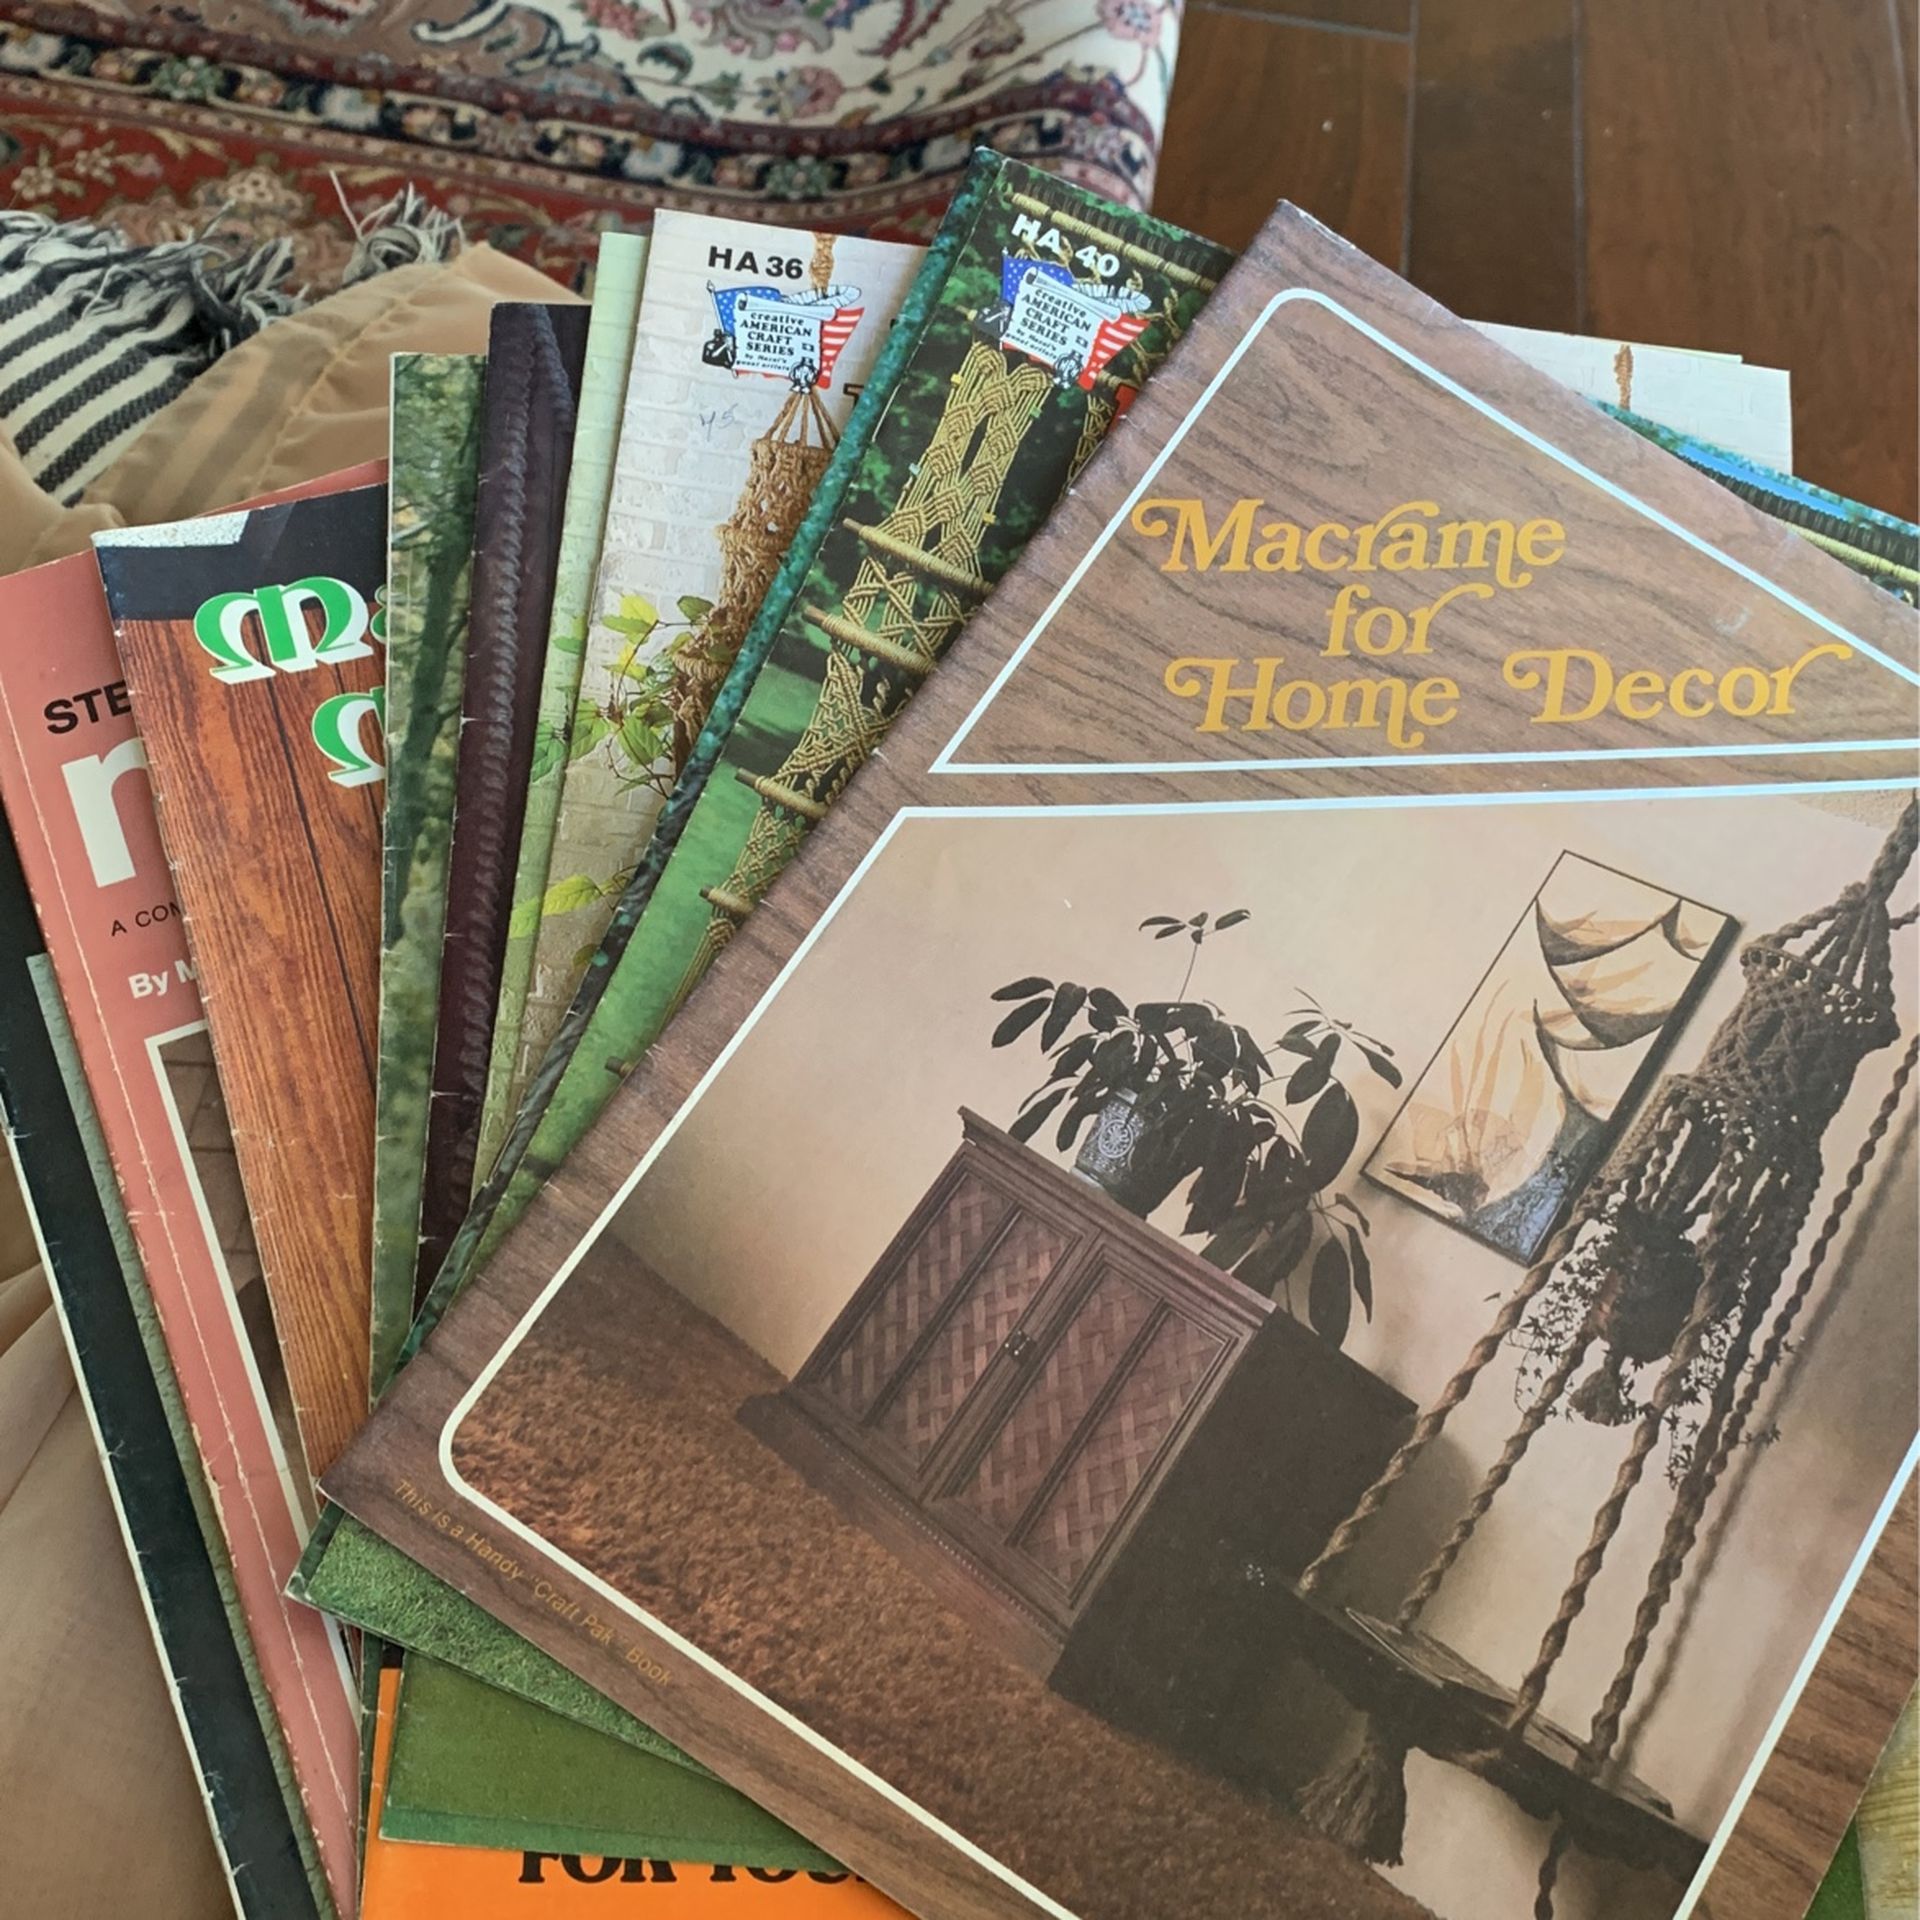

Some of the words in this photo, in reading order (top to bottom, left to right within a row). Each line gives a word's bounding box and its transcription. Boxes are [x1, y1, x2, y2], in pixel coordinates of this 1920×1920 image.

[1011, 213, 1061, 254] HA
[1075, 245, 1120, 278] 40
[708, 245, 759, 274] HA
[766, 256, 804, 279] 36
[1021, 294, 1092, 332] AMERICAN
[1035, 288, 1087, 318] creative
[740, 319, 813, 337] AMERICAN
[750, 312, 805, 326] creative
[1021, 318, 1068, 346] SERIES
[1025, 306, 1070, 333] CRAFT
[746, 341, 795, 357] SERIES
[747, 331, 793, 345] CRAFT
[1130, 497, 1566, 589] Macrame
[1319, 582, 1494, 657] for
[1163, 656, 1460, 749] Home
[1502, 644, 1853, 723] Decor
[111, 919, 128, 938] A
[128, 971, 169, 1000] By
[393, 1478, 434, 1517] This
[431, 1509, 451, 1529] is
[449, 1523, 464, 1538] a
[465, 1532, 525, 1583] Handy
[625, 1646, 674, 1687] Book
